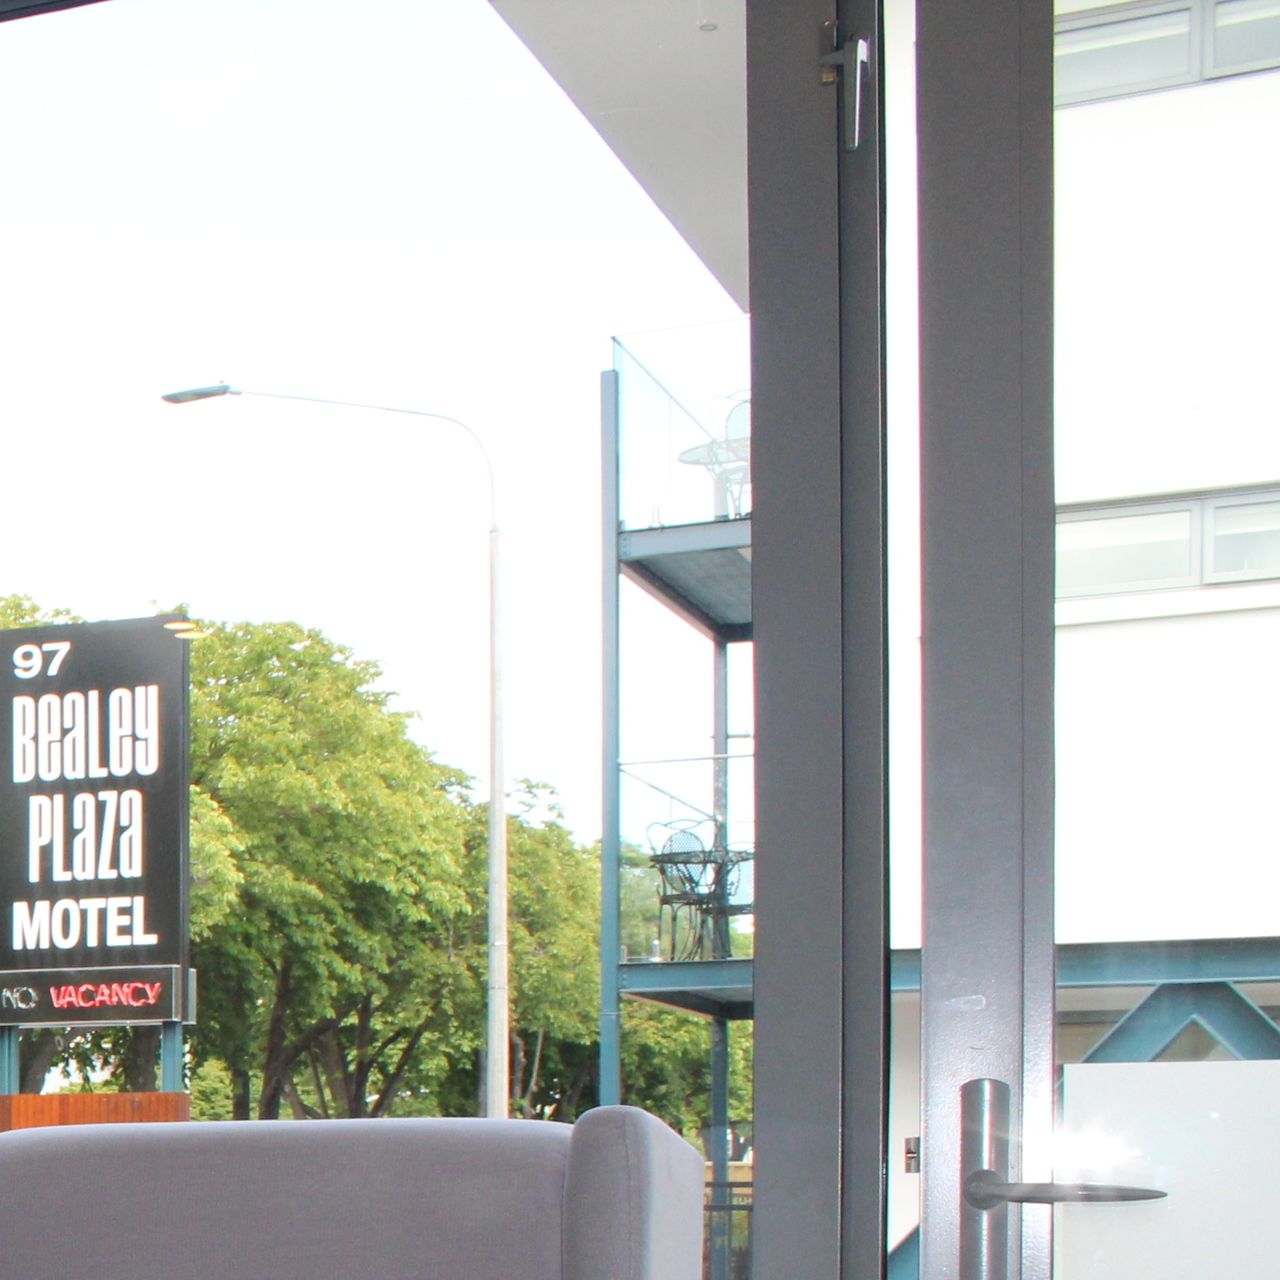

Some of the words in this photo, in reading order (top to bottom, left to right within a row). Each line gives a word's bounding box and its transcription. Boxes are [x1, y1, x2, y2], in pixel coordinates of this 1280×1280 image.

[11, 641, 71, 680] 97
[11, 895, 158, 951] MOTEL
[1, 985, 39, 1010] NO
[49, 981, 163, 1009] VACANCY
